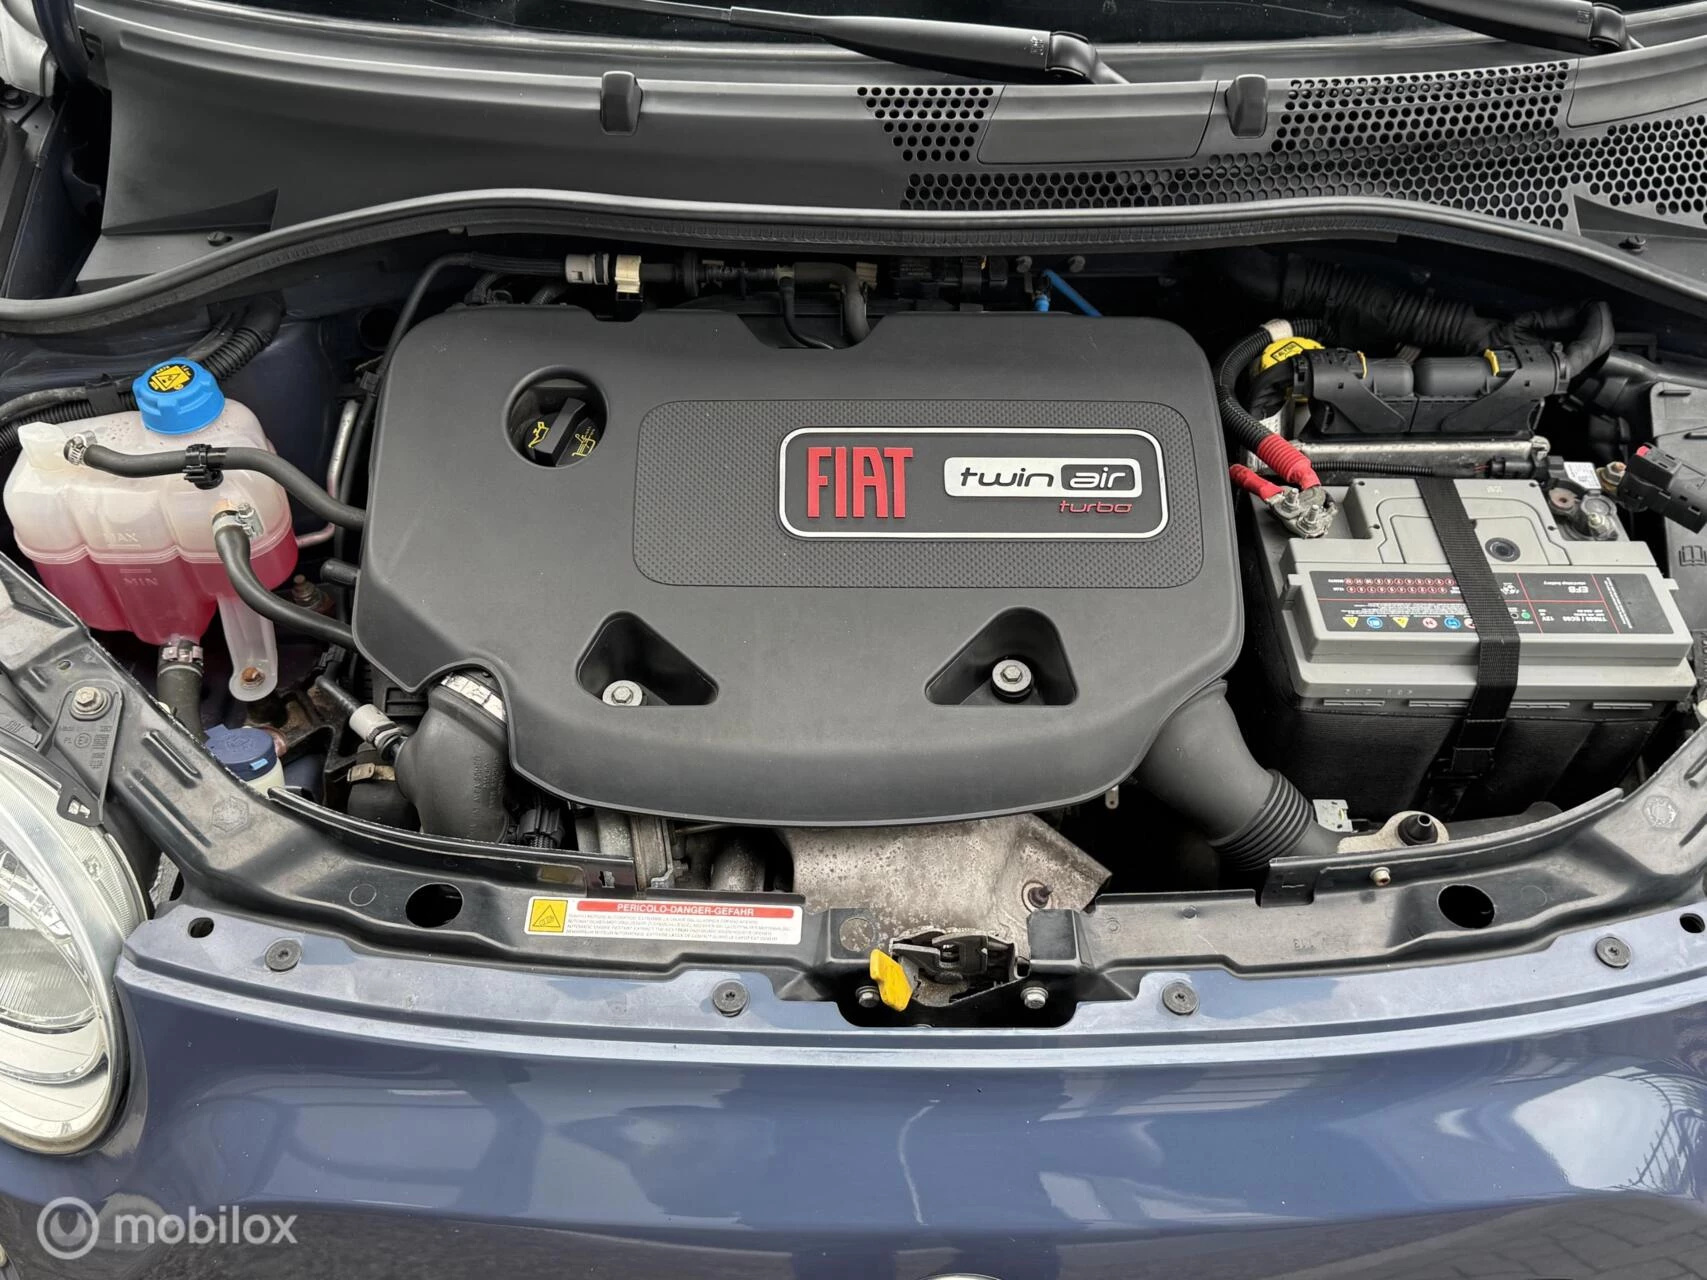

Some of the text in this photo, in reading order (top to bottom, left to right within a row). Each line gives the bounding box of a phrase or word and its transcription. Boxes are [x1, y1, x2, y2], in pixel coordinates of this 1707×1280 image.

[807, 446, 914, 519] FIAT
[959, 465, 1126, 489] twin air
[1058, 499, 1133, 514] turbo
[123, 576, 159, 587] MIN
[616, 902, 755, 917] PERICOLO-DANGER-GEFAHR
